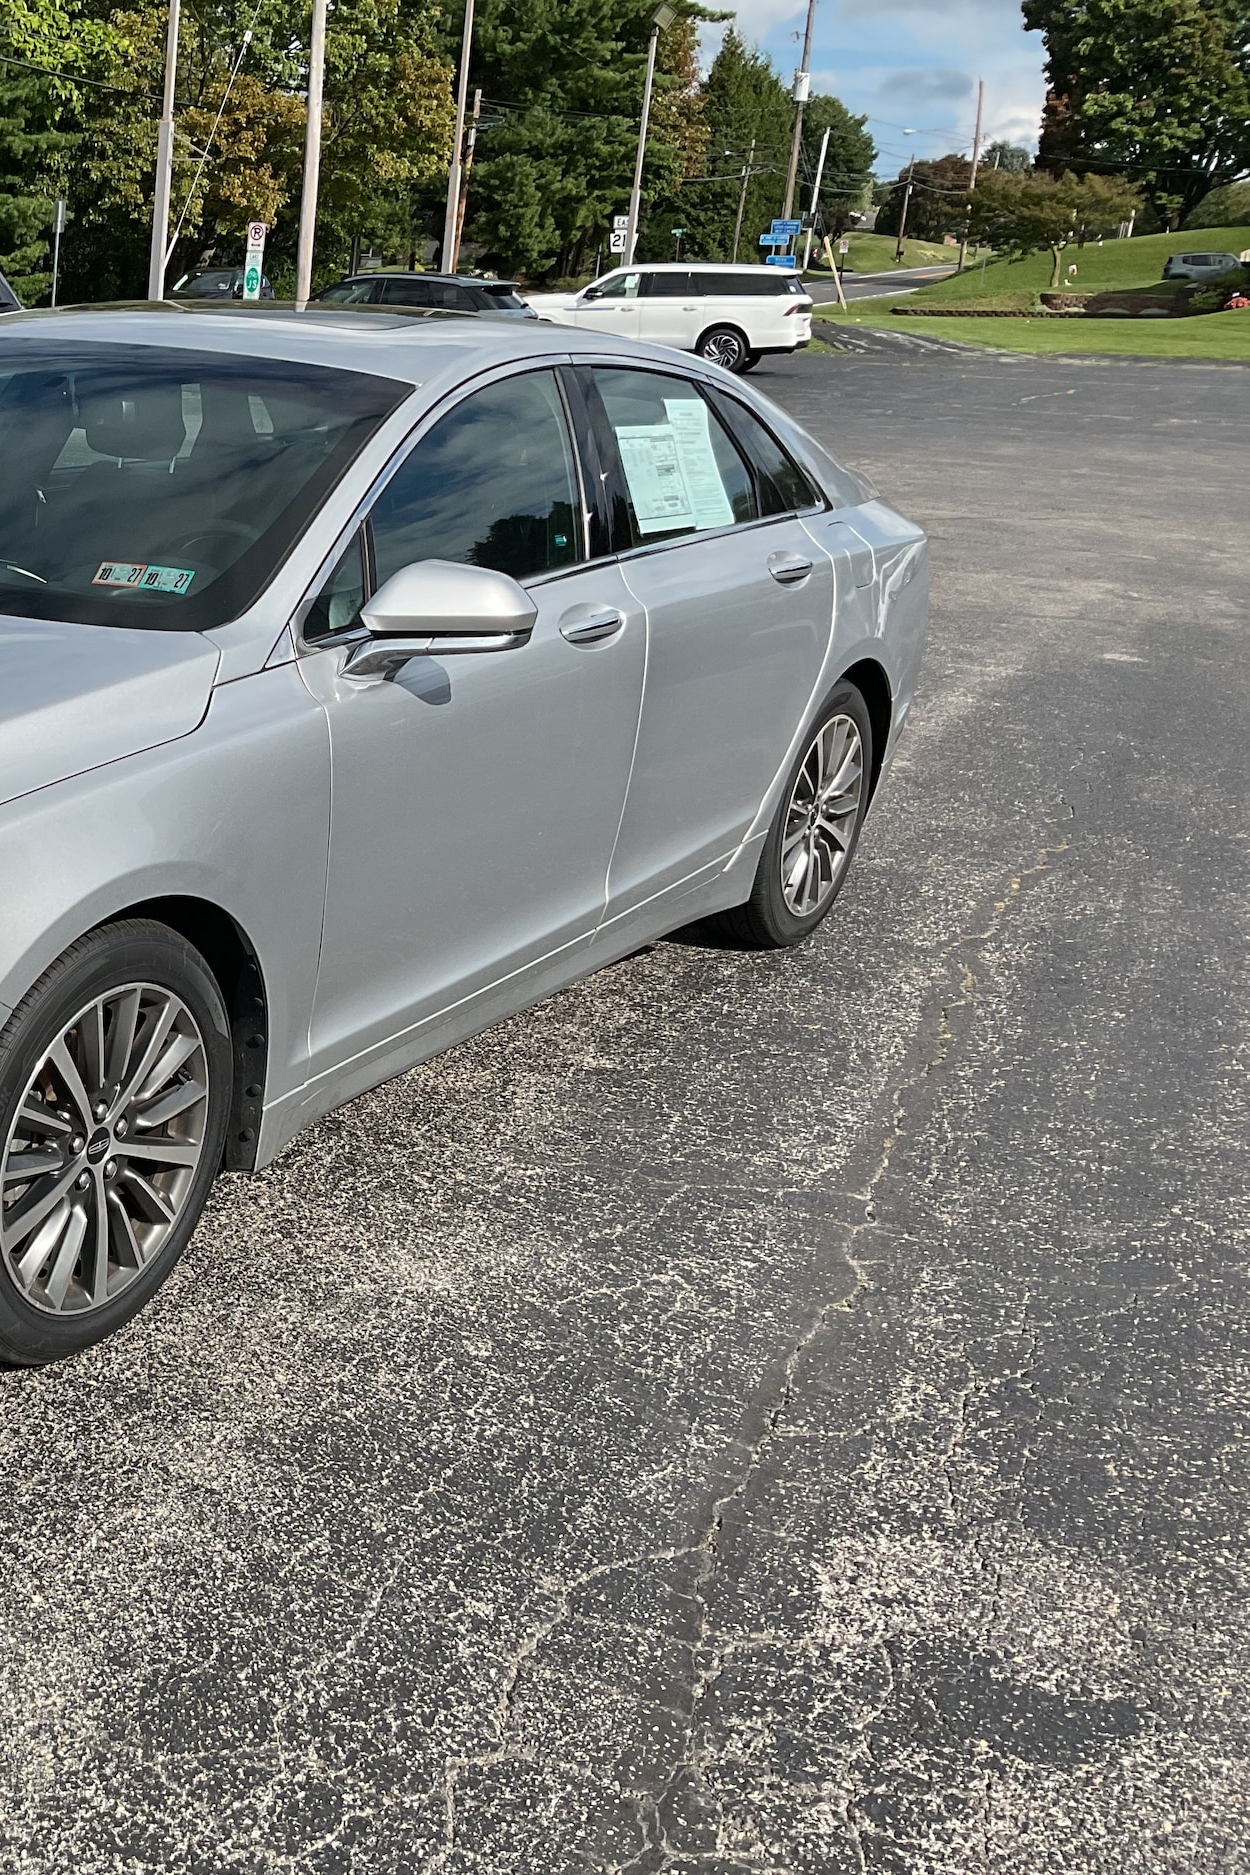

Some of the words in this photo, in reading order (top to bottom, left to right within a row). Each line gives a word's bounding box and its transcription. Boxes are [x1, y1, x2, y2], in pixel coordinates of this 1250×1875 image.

[612, 234, 627, 247] 21
[127, 568, 142, 583] 27
[173, 573, 190, 590] 27
